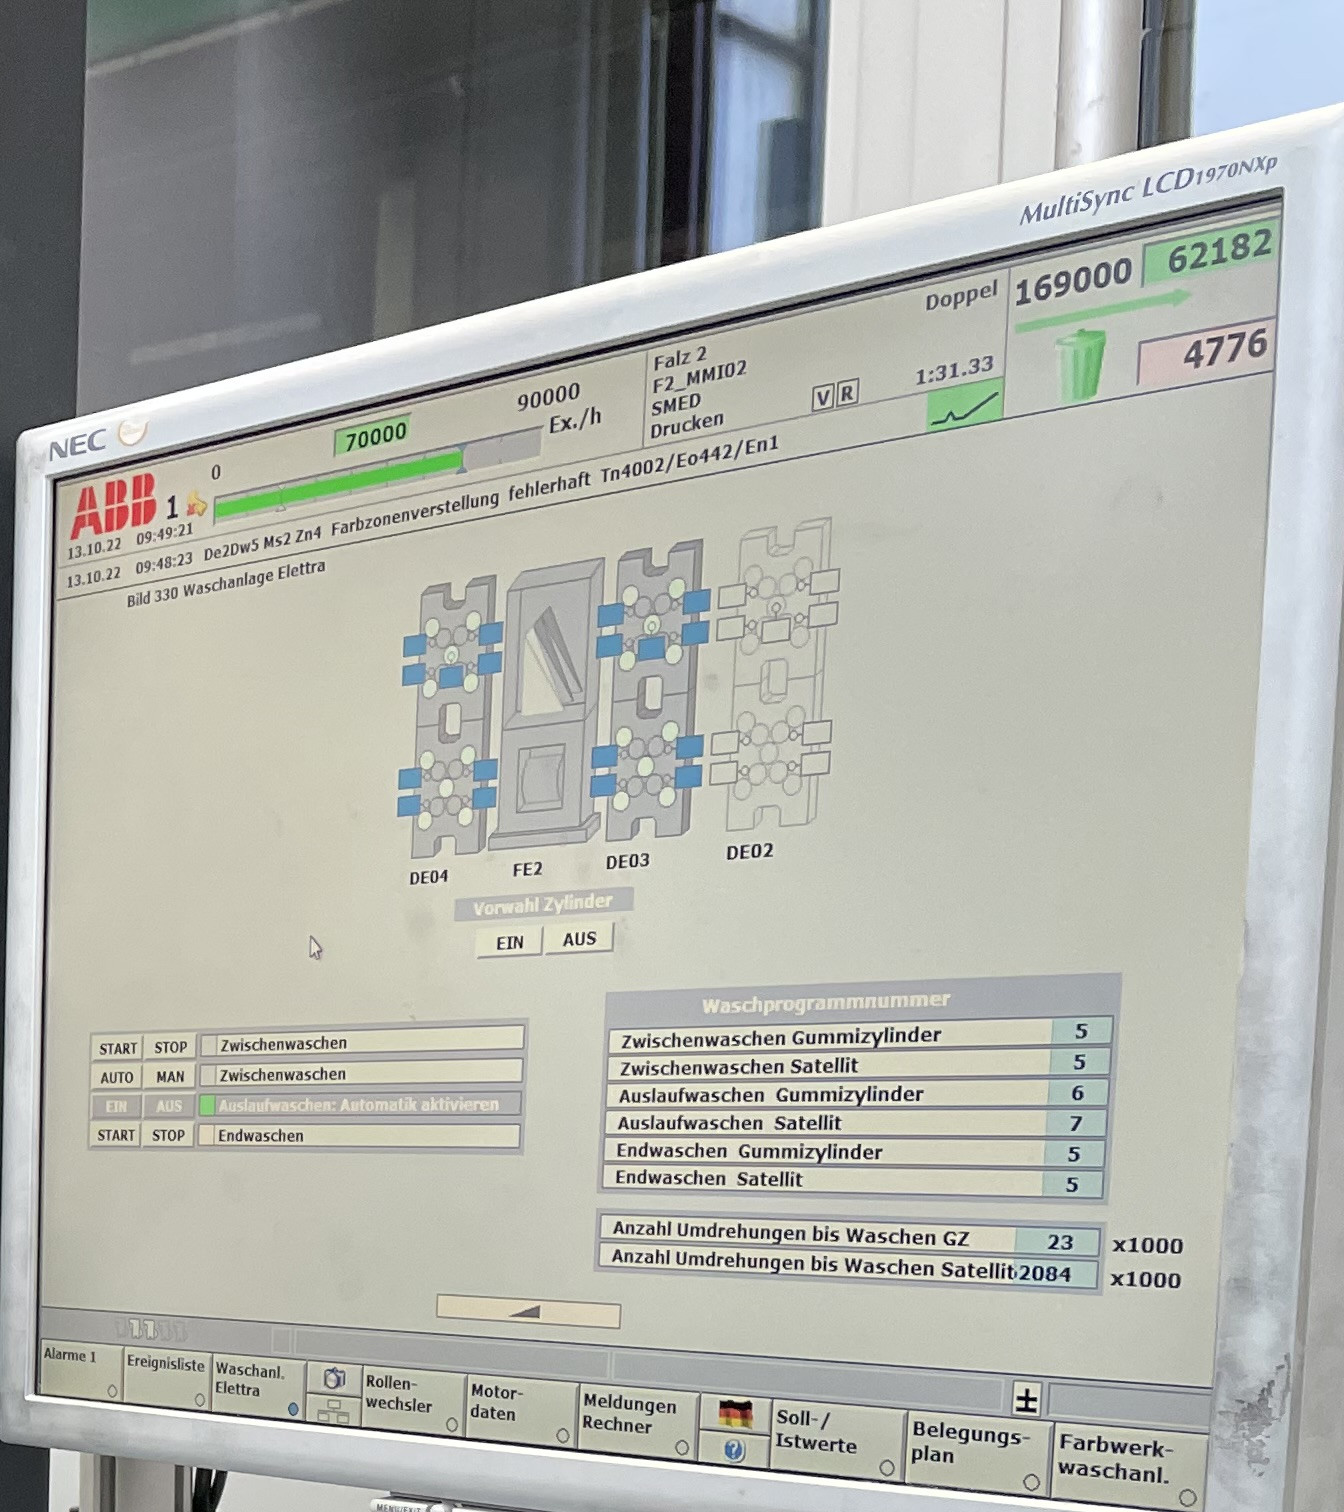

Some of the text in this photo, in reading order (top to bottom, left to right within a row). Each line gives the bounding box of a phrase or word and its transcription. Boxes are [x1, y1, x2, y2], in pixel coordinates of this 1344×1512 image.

[1019, 187, 1134, 227] MultiSync
[1168, 229, 1273, 274] 62182
[1015, 259, 1132, 306] 169000
[925, 280, 999, 312] Doppel
[654, 346, 708, 373] Falz 2
[1184, 328, 1268, 370] 4776
[916, 356, 994, 386] 1:31.33
[518, 383, 580, 411] 90000
[817, 389, 831, 407] V
[841, 384, 854, 402] R
[651, 394, 701, 416] SMED
[549, 408, 601, 434] Ex./h
[651, 412, 724, 439] Drucken
[49, 429, 107, 461] NEC
[346, 423, 406, 452] 70000
[211, 465, 221, 480] 0
[70, 472, 157, 540] ABB
[167, 496, 178, 519] 1
[67, 566, 121, 588] 13.10.22
[136, 552, 193, 574] 09:48:23
[204, 537, 259, 561] De2Dw5
[264, 531, 290, 550] Ms2
[296, 527, 321, 543] Zn4
[331, 490, 499, 536] Farbzonenverstellung
[509, 472, 591, 500] fehlerhaft
[68, 523, 193, 560] 13.10.22 09:49:21
[128, 561, 325, 608] Bild 330 Waschanlage Elettra
[606, 853, 650, 870] DE03
[726, 843, 774, 861] DE02
[409, 869, 448, 885] DE04
[513, 861, 543, 877] FE2
[474, 893, 613, 916] Vorwahl Zylinder
[496, 936, 524, 951] EIN
[563, 931, 597, 947] AUS
[220, 1036, 347, 1054] Zwischenwaschen
[621, 1022, 1088, 1049] Zwischenwaschen Gummizylinder 5
[99, 1042, 137, 1055] START
[154, 1041, 187, 1054] STOP
[219, 1067, 346, 1084] Zwischenwaschen
[620, 1053, 1086, 1077] Zwischenwaschen Satellit 5
[100, 1071, 134, 1084] AUTO
[156, 1071, 184, 1083] MAN
[619, 1084, 1084, 1107] Auslaufwaschen Gummizylinder 6
[617, 1113, 1083, 1132] Auslaufwaschen Satellit 7
[97, 1129, 135, 1142] START
[152, 1129, 185, 1142] STOP
[218, 1129, 304, 1143] Endwaschen
[616, 1141, 1081, 1163] Endwaschen Gummizylinder 5
[615, 1168, 1079, 1193] Endwaschen Satellit 5
[612, 1219, 1184, 1255] Anzahl Umdrehungen bis Waschen GZ 23 x1000
[611, 1247, 671, 1266] Anzahl
[676, 1251, 806, 1275] Umdrehungen
[810, 1255, 839, 1273] bis
[845, 1257, 935, 1278] Waschen
[1018, 1264, 1072, 1283] 2084
[1110, 1271, 1182, 1289] x1000
[44, 1347, 87, 1362] Alarme
[127, 1354, 205, 1373] Ereignisliste
[216, 1362, 285, 1379] Waschanl.
[216, 1381, 260, 1397] Elettra
[366, 1374, 418, 1393] Rollen-
[471, 1383, 524, 1402] Motor-
[365, 1395, 433, 1415] wechsler
[470, 1402, 517, 1422] daten
[583, 1391, 678, 1417] Meldungen
[582, 1414, 653, 1435] Rechner
[913, 1420, 1031, 1450] Belegungs-
[775, 1432, 858, 1456] Istwerte
[1060, 1434, 1175, 1460] Farbwerk-
[911, 1443, 955, 1468] plan
[1058, 1459, 1170, 1486] waschanl.
